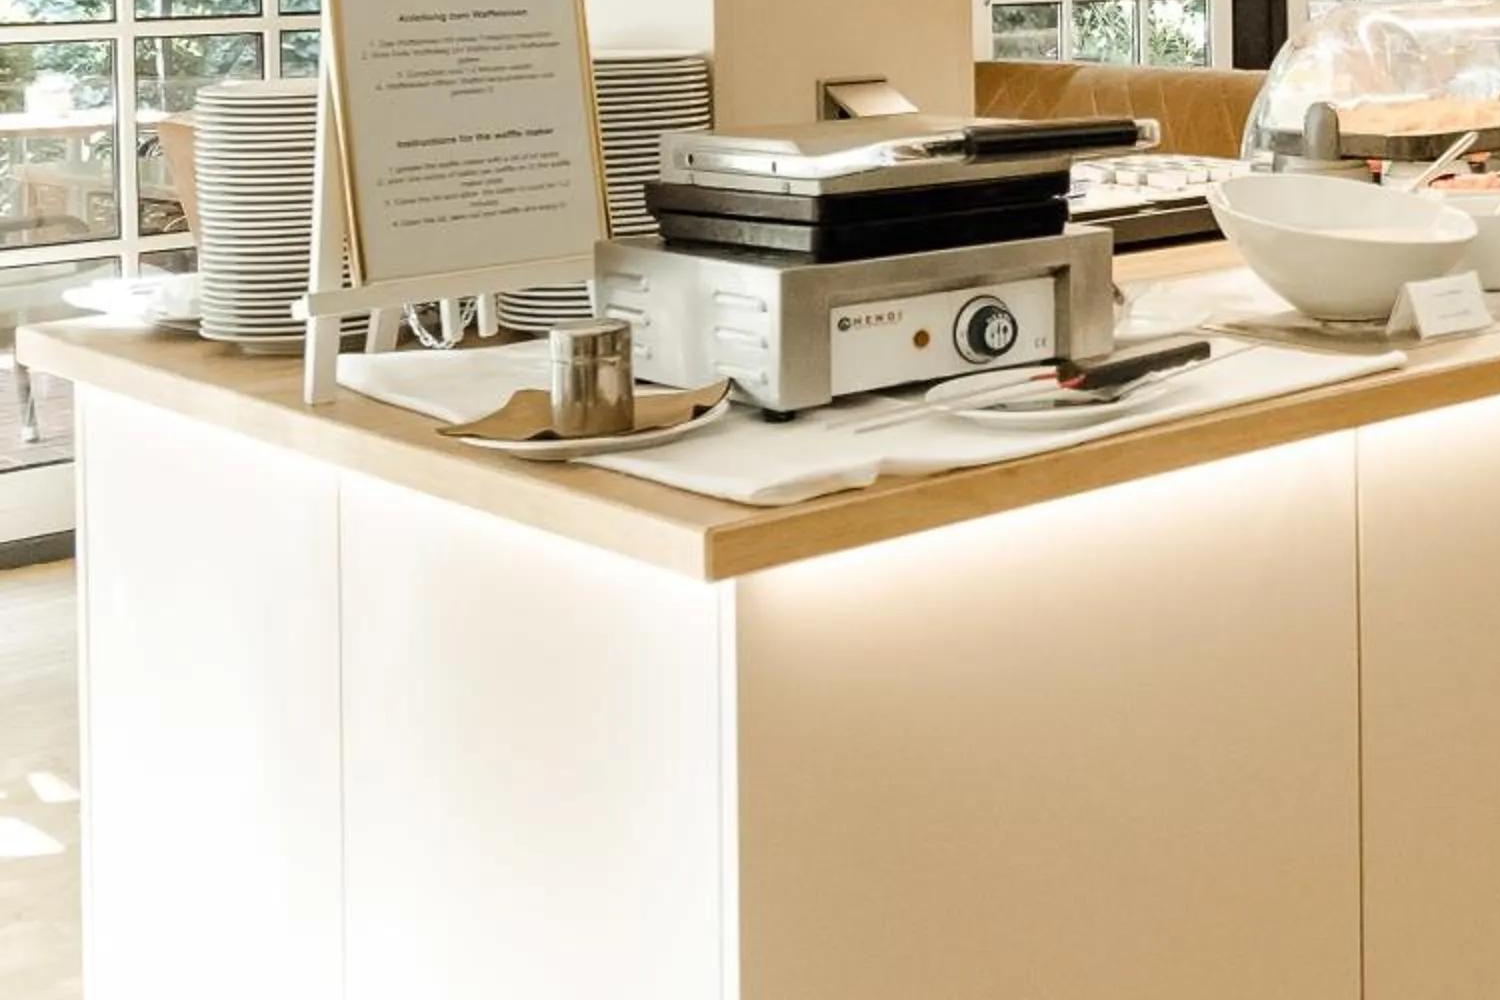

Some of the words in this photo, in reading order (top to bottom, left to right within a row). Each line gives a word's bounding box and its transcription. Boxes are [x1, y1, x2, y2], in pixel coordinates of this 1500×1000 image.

[459, 134, 473, 143] for
[475, 132, 491, 141] the
[495, 129, 523, 139] waffle
[853, 311, 903, 326] HENDI
